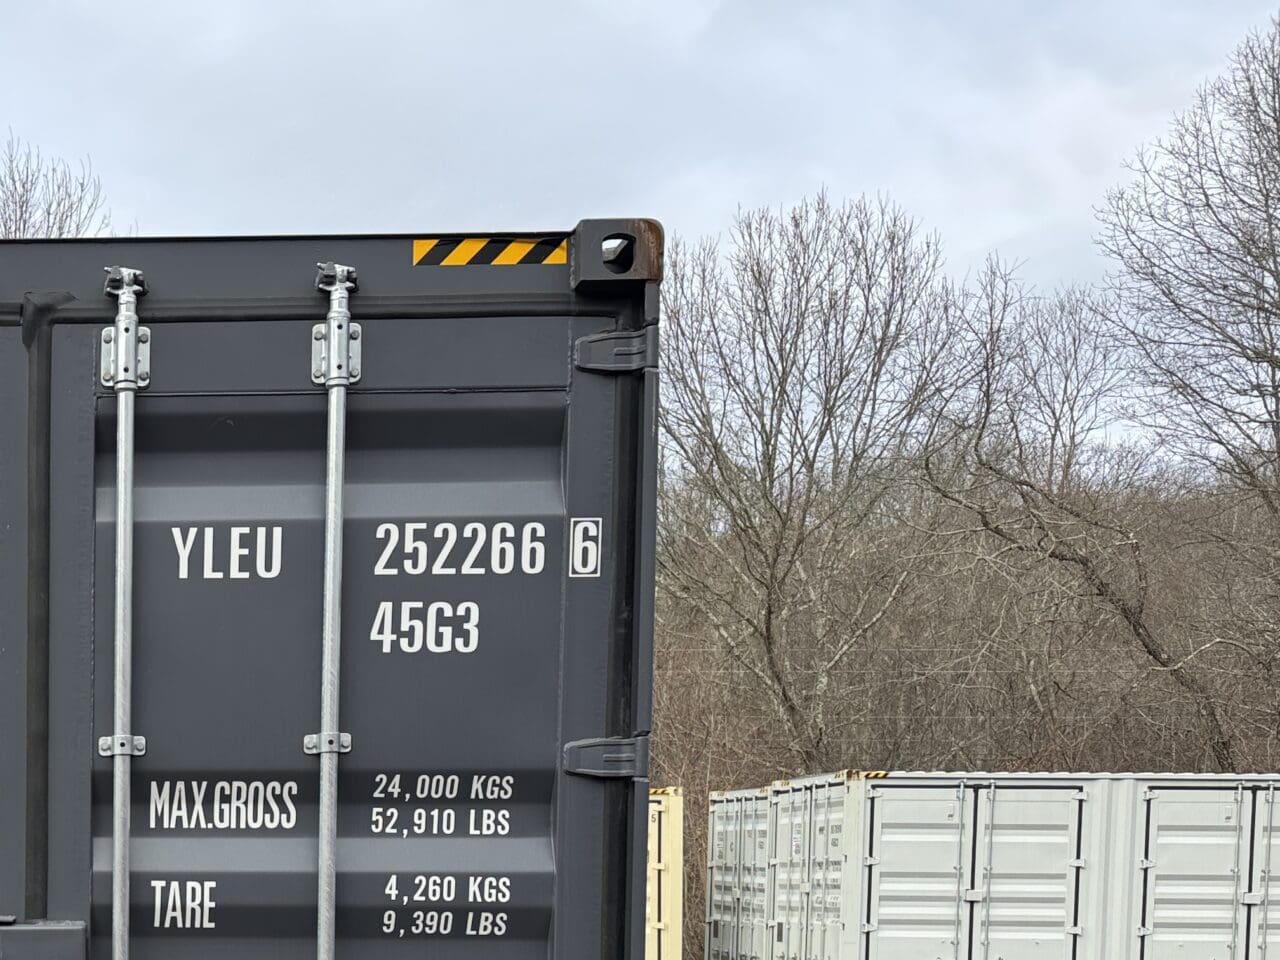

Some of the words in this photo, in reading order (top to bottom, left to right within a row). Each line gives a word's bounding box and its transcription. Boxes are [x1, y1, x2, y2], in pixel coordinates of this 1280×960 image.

[172, 526, 283, 579] YLEU
[374, 521, 546, 576] 252266
[572, 521, 599, 575] 6
[370, 601, 480, 653] 45G3
[149, 781, 298, 829] MAX.GROSS
[373, 774, 460, 802] 24,000
[470, 775, 515, 799] KGS
[371, 808, 456, 838] 52,910
[469, 809, 510, 835] LBS
[151, 881, 217, 929] TARE
[384, 875, 456, 905] 4,260
[468, 876, 511, 902] KGS
[382, 911, 453, 937] 9,390
[465, 911, 508, 936] LBS
